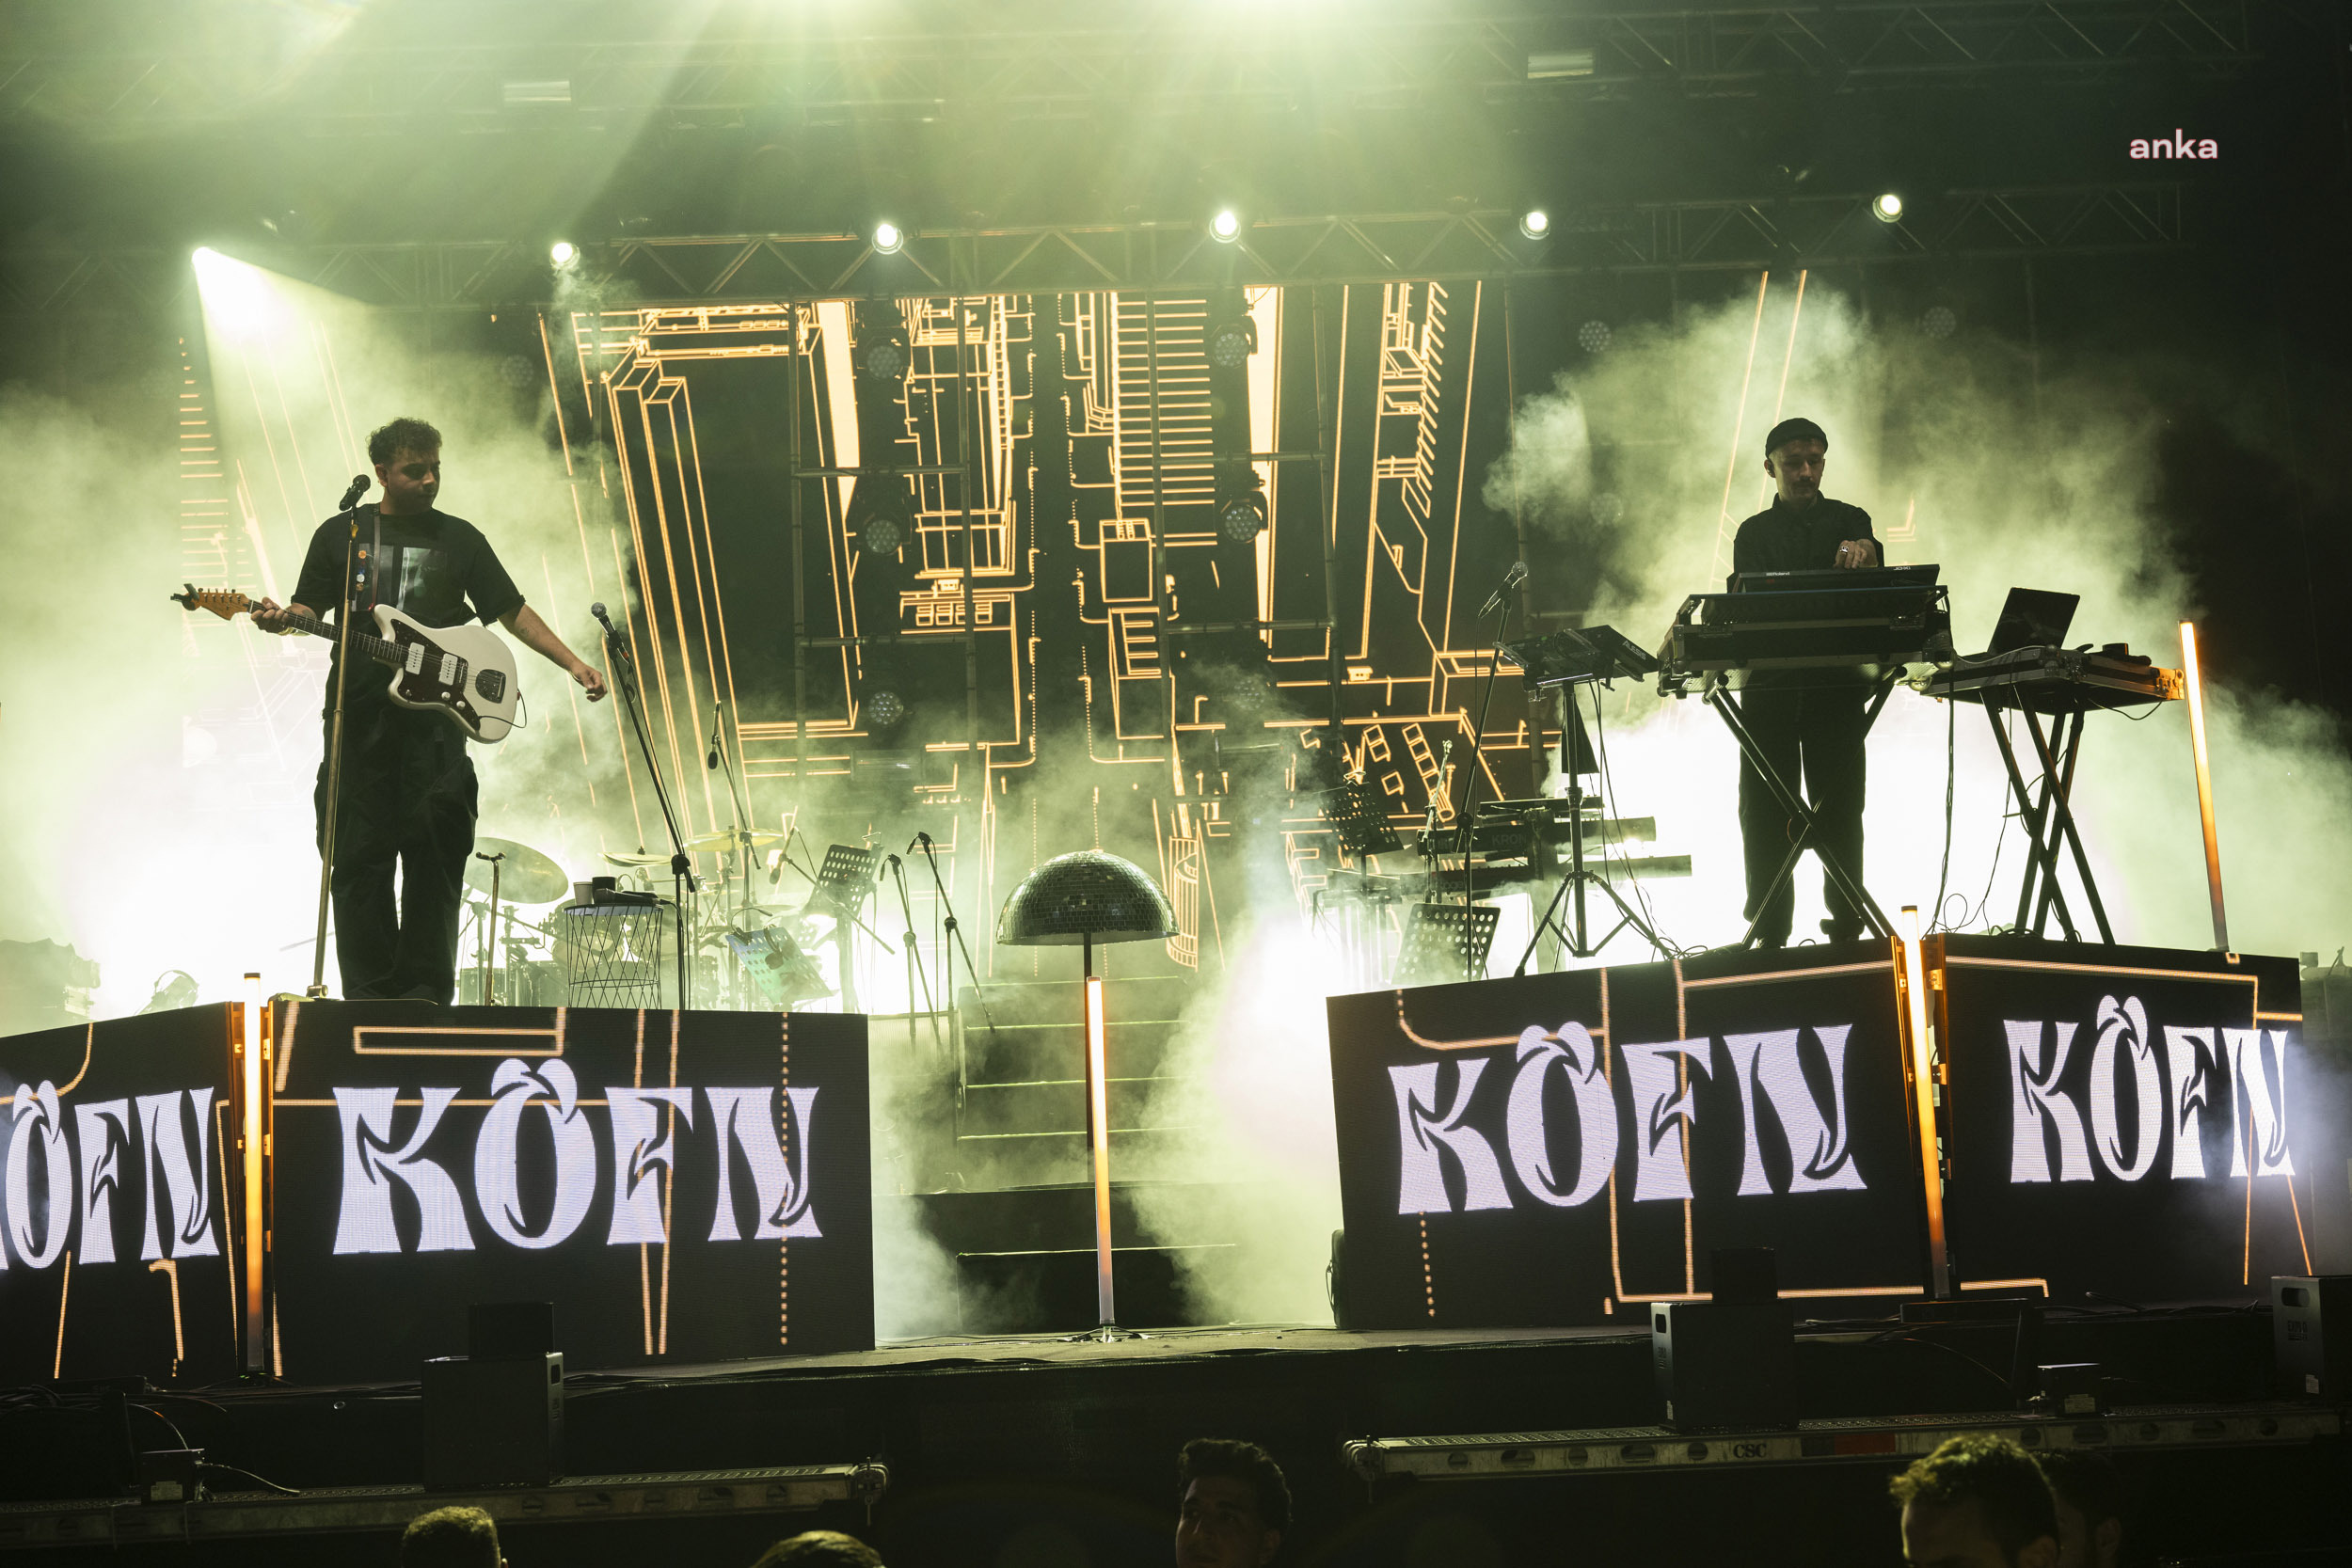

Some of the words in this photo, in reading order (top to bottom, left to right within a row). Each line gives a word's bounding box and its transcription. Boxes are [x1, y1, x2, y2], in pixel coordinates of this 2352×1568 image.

[1622, 640, 1646, 660] ALESIS
[0, 1079, 220, 1271] ÖFN
[332, 1058, 823, 1255] KÖFN
[1388, 1021, 1868, 1215] KÖFN
[2003, 994, 2296, 1183] KÖFN
[1733, 1443, 1768, 1459] CSC
